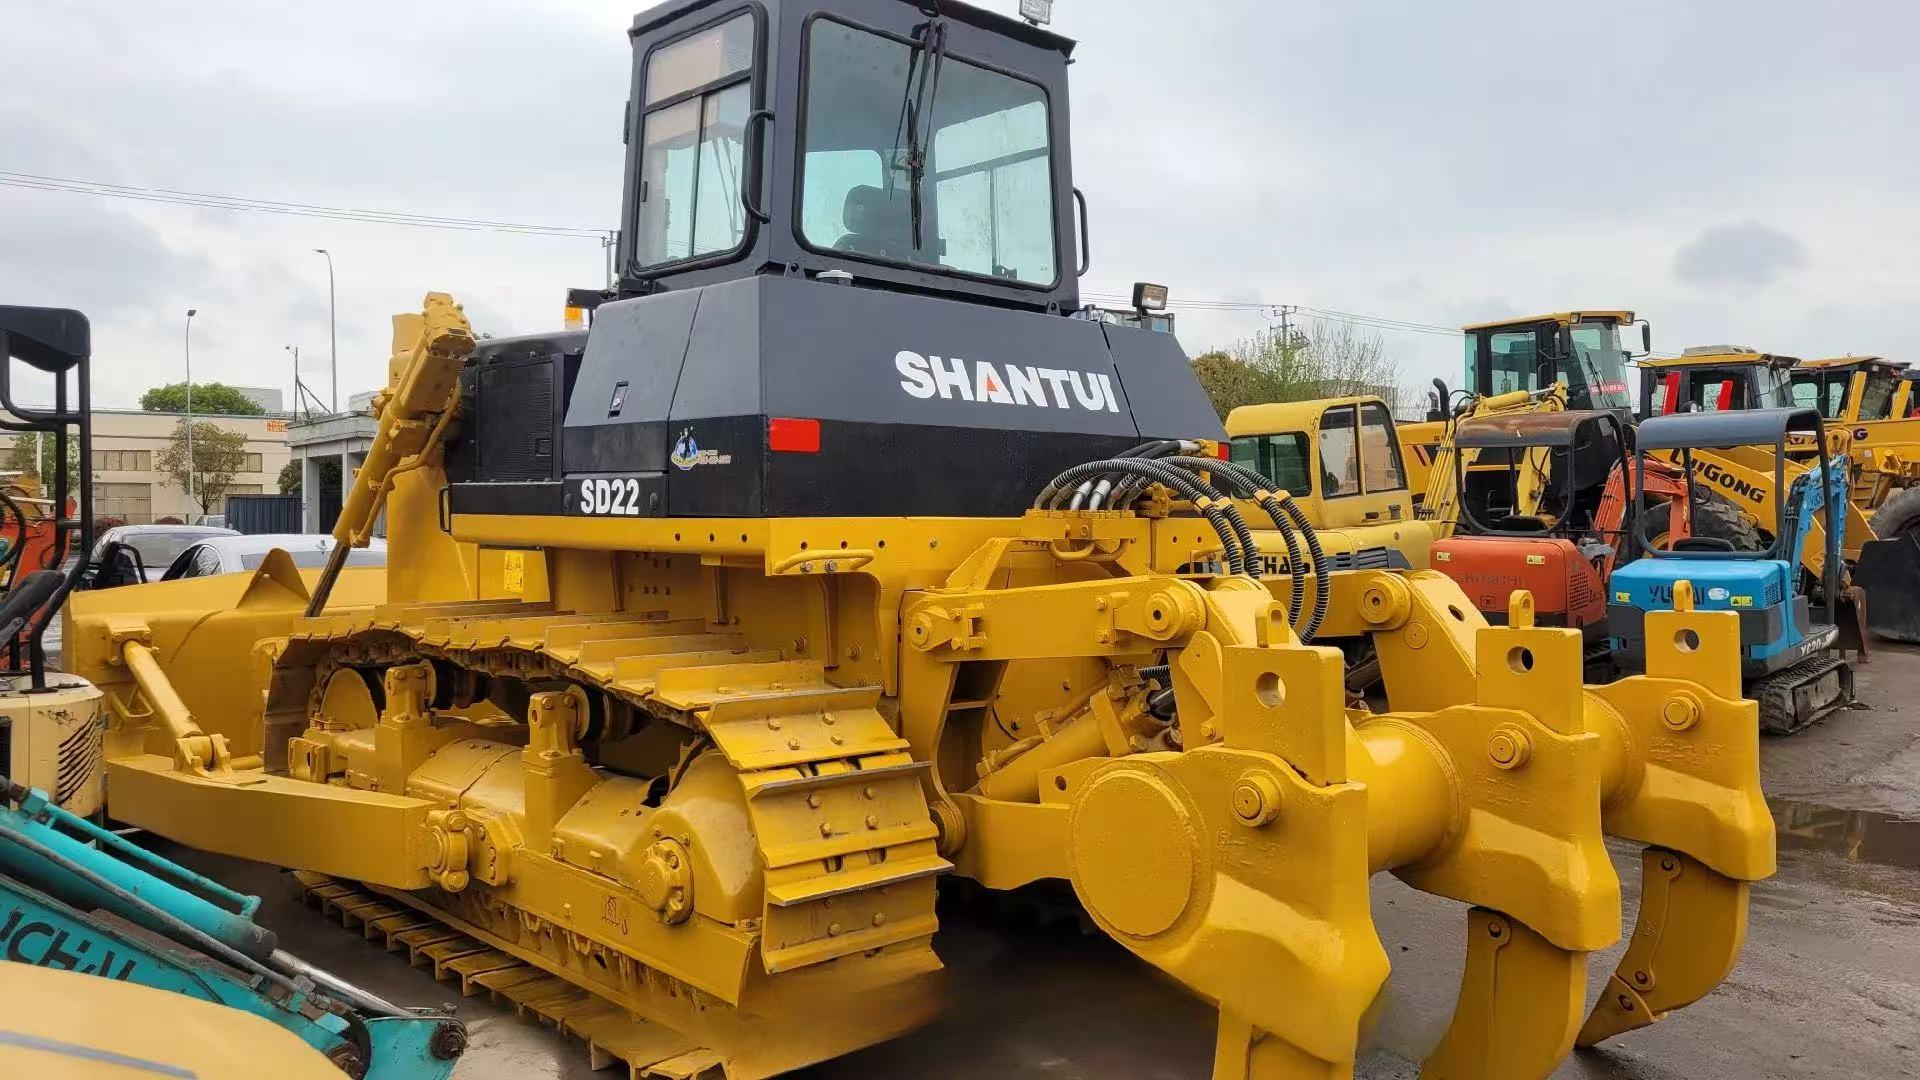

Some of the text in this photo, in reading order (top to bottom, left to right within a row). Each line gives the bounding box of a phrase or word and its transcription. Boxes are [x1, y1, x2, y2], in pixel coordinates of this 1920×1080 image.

[895, 350, 1120, 413] SHANTUI
[580, 479, 639, 515] SD22
[1669, 447, 1767, 504] LUGONG
[1649, 585, 1705, 605] YUAI
